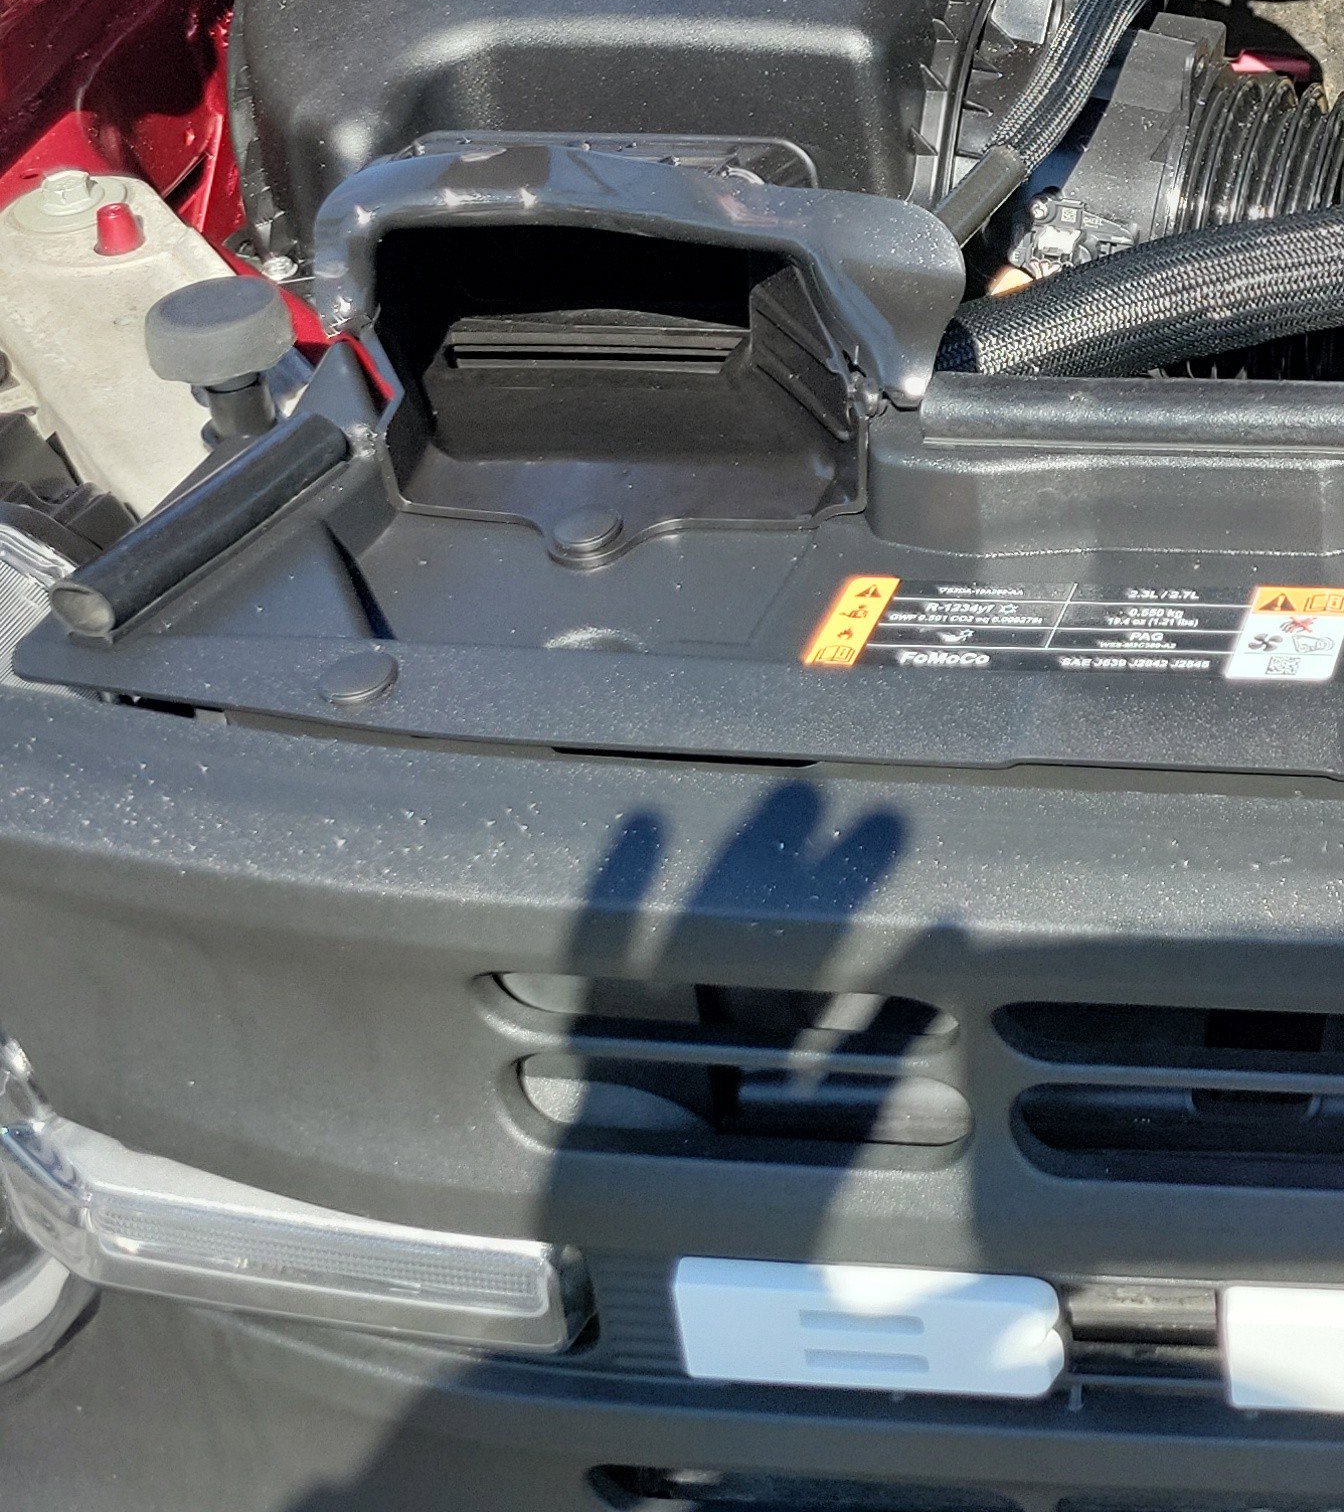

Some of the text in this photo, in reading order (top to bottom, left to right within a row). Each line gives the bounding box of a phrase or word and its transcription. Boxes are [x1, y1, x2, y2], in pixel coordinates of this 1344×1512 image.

[1127, 589, 1159, 599] 2.3L
[1168, 590, 1200, 600] 2.7L
[924, 602, 994, 615] R-1234yf
[1166, 609, 1184, 620] kg
[1129, 631, 1165, 642] PAG
[899, 651, 991, 666] FoMoCo
[1060, 657, 1093, 668] SAE
[1093, 658, 1127, 668] J639
